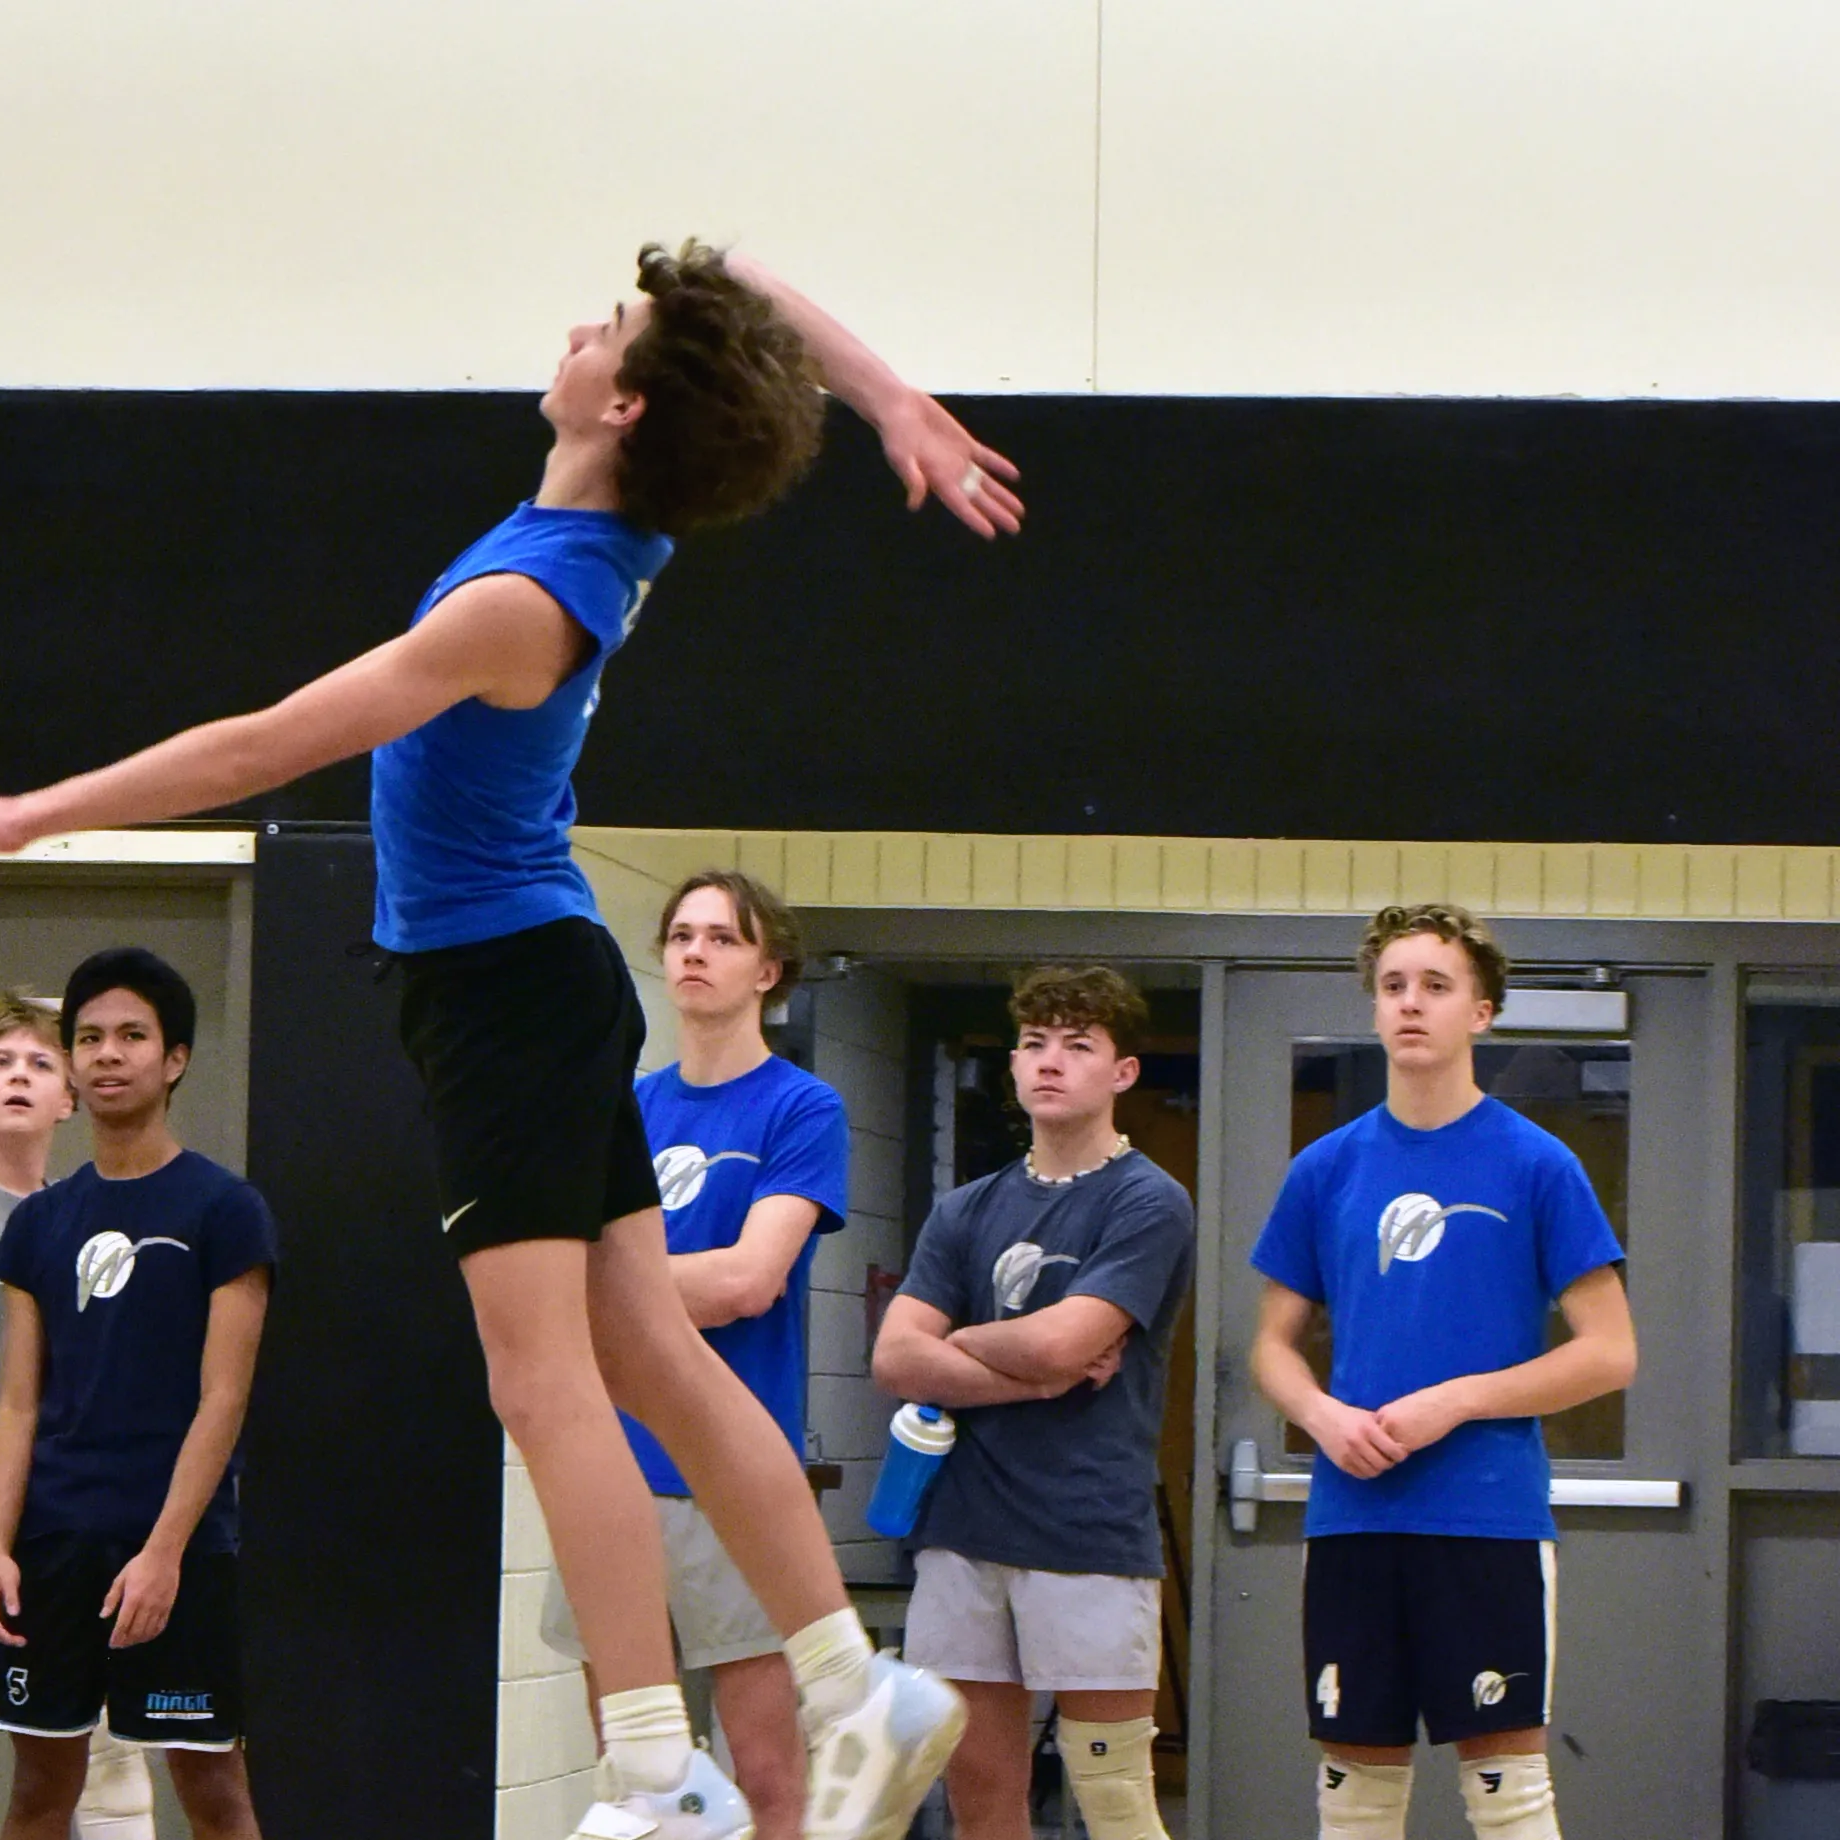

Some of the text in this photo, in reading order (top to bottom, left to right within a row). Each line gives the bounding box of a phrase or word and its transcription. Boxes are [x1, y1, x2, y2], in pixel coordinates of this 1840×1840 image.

[6, 1666, 29, 1706] 5
[146, 1693, 214, 1711] MAGIC
[1316, 1663, 1340, 1718] 4
